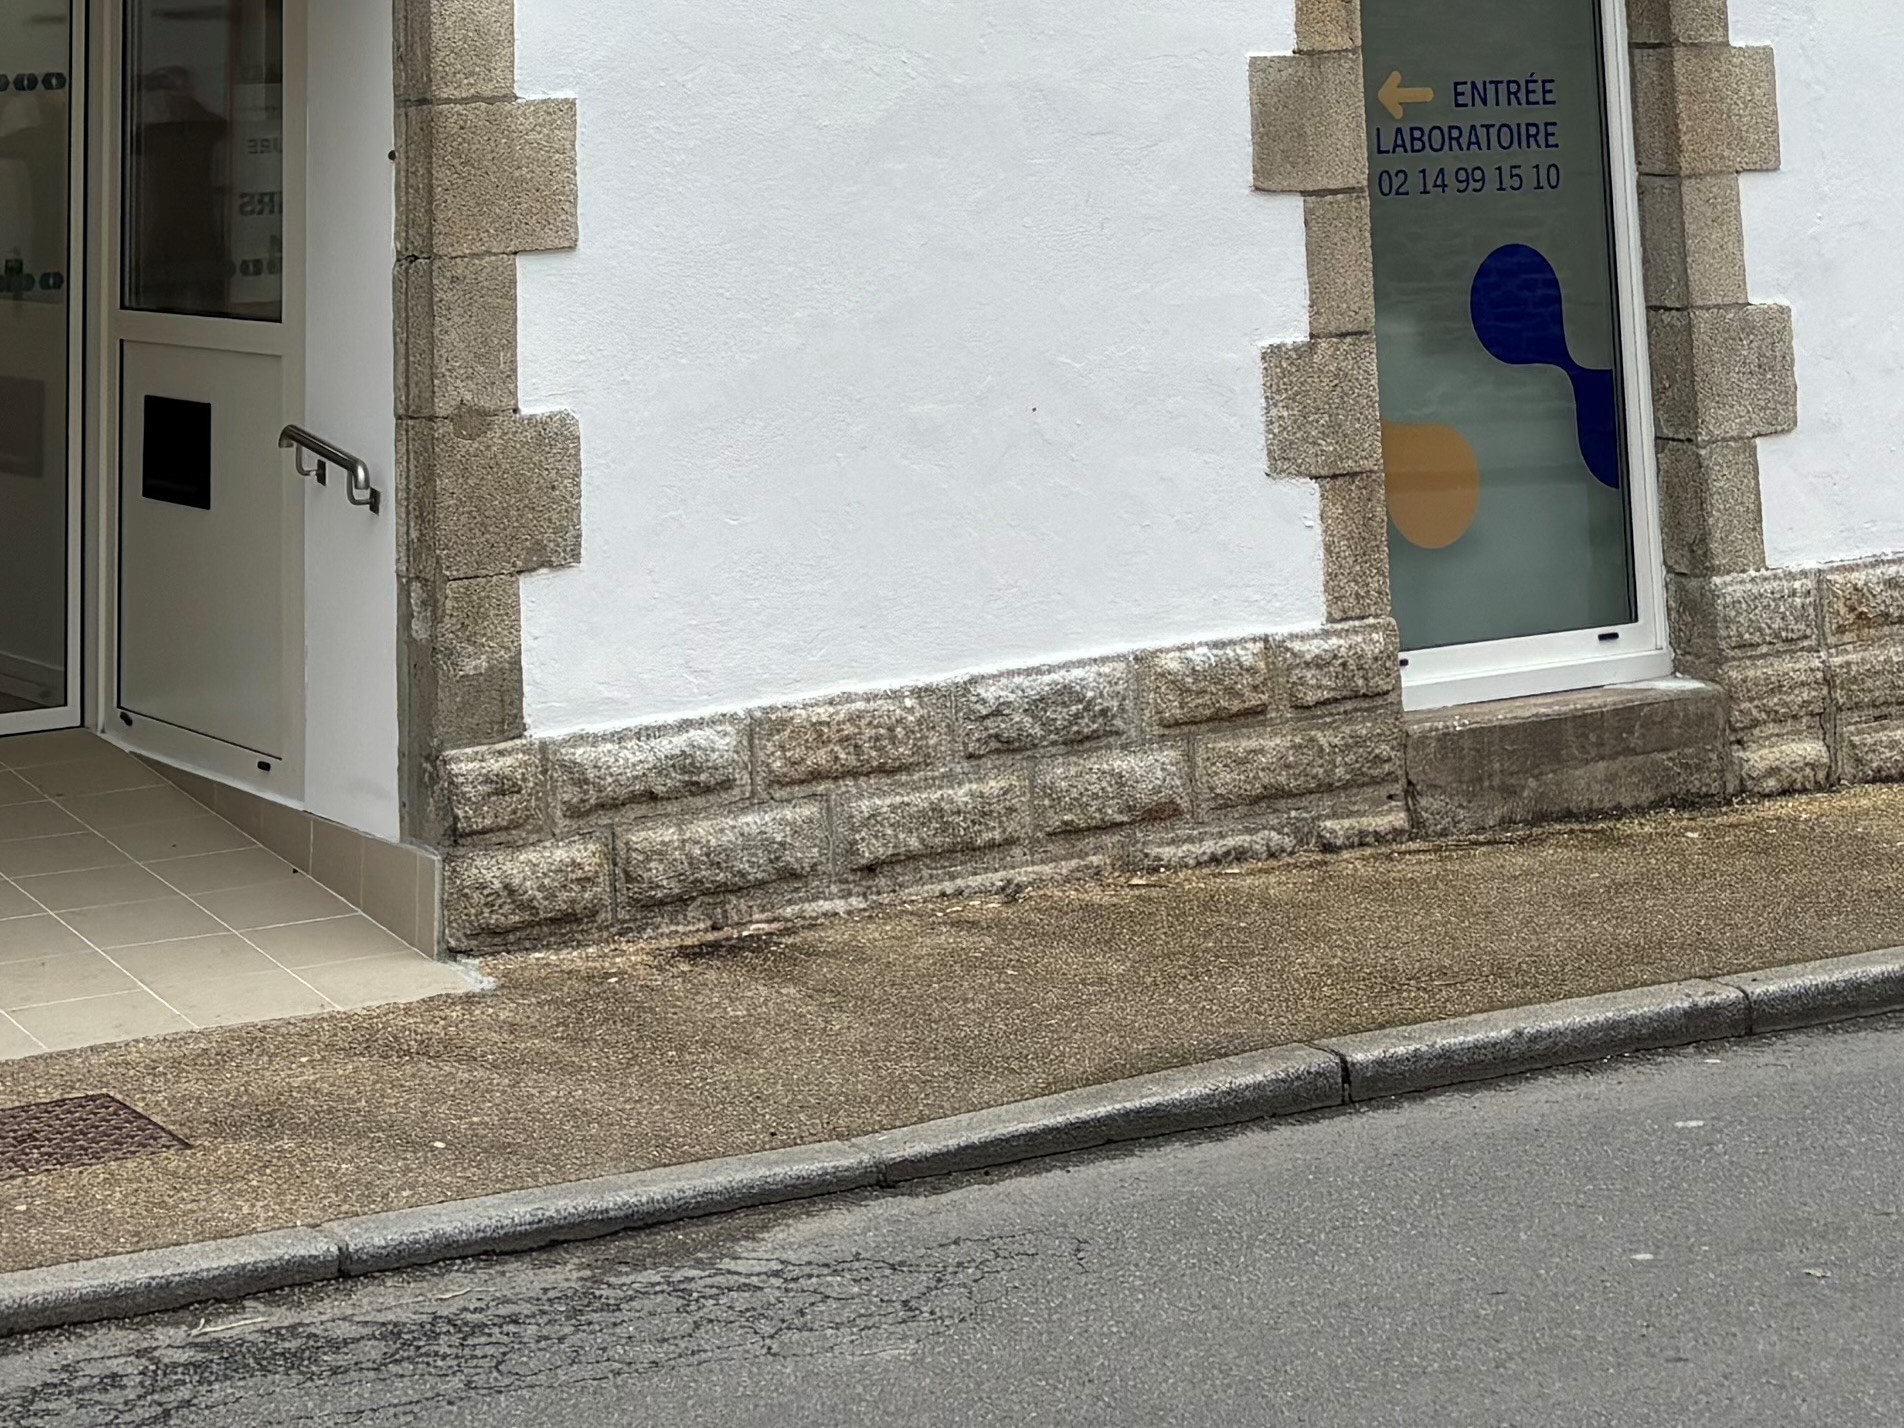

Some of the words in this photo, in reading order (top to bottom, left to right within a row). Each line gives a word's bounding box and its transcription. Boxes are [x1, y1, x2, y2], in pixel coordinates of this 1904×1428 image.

[1453, 72, 1557, 108] ENTRÉE
[1376, 121, 1560, 155] LABORATOIRE
[1378, 169, 1410, 197] 02
[1418, 167, 1448, 195] 14
[1455, 166, 1486, 194] 99
[1494, 164, 1524, 192] 15
[1532, 162, 1560, 190] 10
